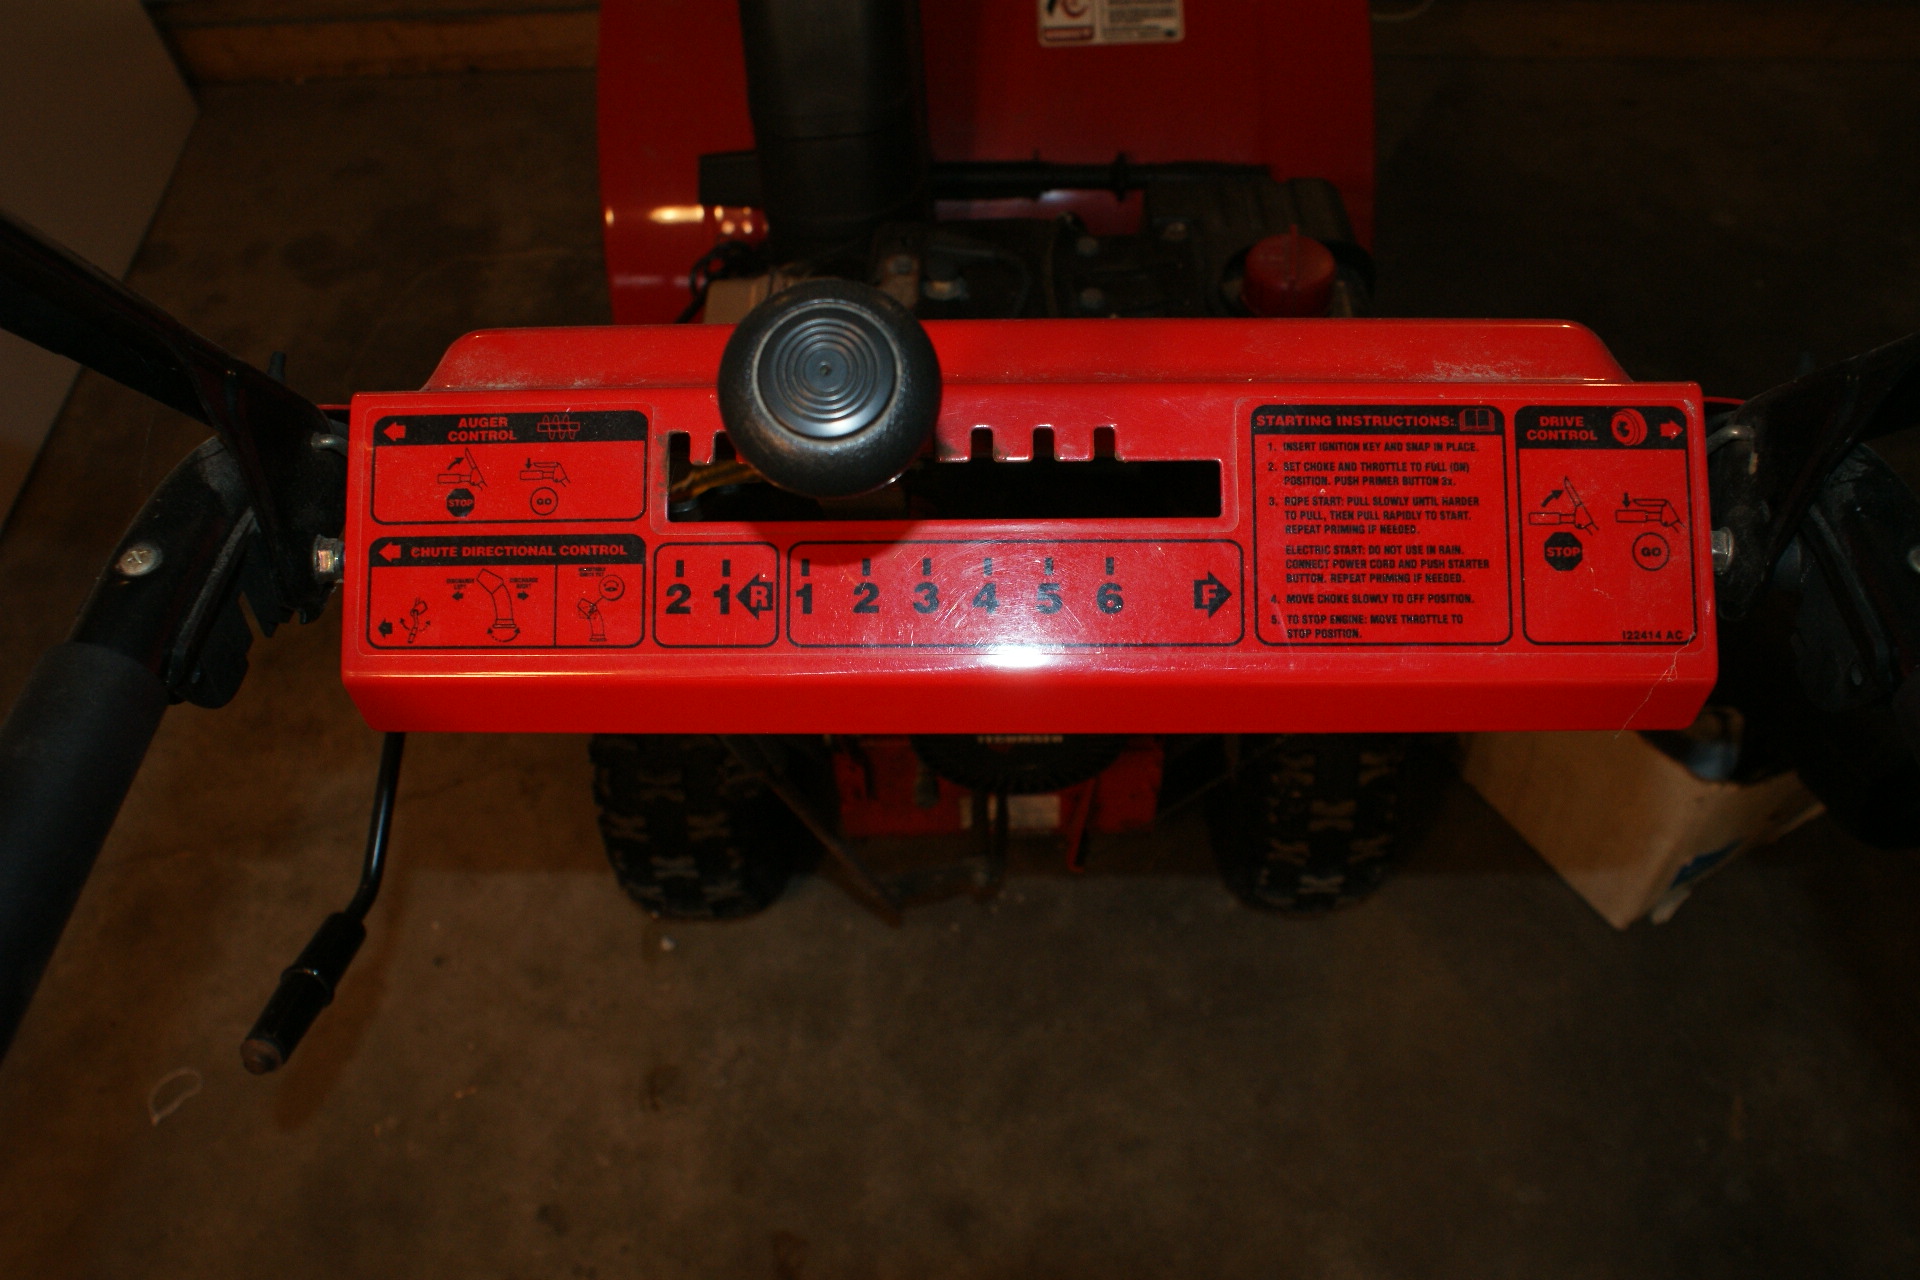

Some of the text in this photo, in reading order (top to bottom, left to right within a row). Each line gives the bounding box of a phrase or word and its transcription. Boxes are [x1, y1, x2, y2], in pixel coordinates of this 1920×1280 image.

[458, 417, 508, 428] AUGER
[1256, 415, 1455, 427] STARTING INSTRUCTIONS:
[1540, 416, 1584, 427] DRIVE
[447, 431, 517, 442] CONTROL
[1527, 430, 1598, 441] CONTROL
[1268, 442, 1479, 452] 1. INSERT IGNITION KEY AND SNAP IN PLACE.
[1268, 462, 1470, 473] 2. SET CHOKE AND THROTTLE TO FULL (ON)
[1284, 476, 1331, 486] POSITION.
[1334, 476, 1359, 486] PUSH
[1362, 476, 1399, 486] PRIMER
[1402, 476, 1439, 486] BUTTON
[449, 499, 472, 507] STOP
[536, 498, 552, 506] GO
[1269, 496, 1479, 506] 3. ROPE START: PULL SLOWLY UNTIL HARDER
[1285, 510, 1472, 521] TO PULL, THEN PULL RAPIDLY TO START.
[1285, 525, 1420, 534] REPEAT PRIMING IF NEEDED.
[410, 544, 628, 558] CHUTE DIRECTIONAL CONTROL
[1286, 545, 1464, 555] ELECTRIC START: DO NOT USE IN RAIN.
[1546, 547, 1580, 557] STOP
[1640, 547, 1662, 557] GO
[1285, 559, 1489, 569] CONNECT POWER CORD AND PUSH STARTER
[1286, 573, 1465, 583] BUTTON. REPEAT PRIMING IF NEEDED.
[665, 583, 730, 615] 2 1
[795, 582, 1124, 614] 1 2 3 4 5 6
[1271, 594, 1475, 604] 4. MOVE CHOKE SLOWLY TO OFF POSITION.
[1271, 614, 1463, 624] 5. TO STOP ENGINE: MOVE THROTTLE TO
[1287, 629, 1362, 638] STOP POSITION.
[1666, 631, 1683, 640] AC
